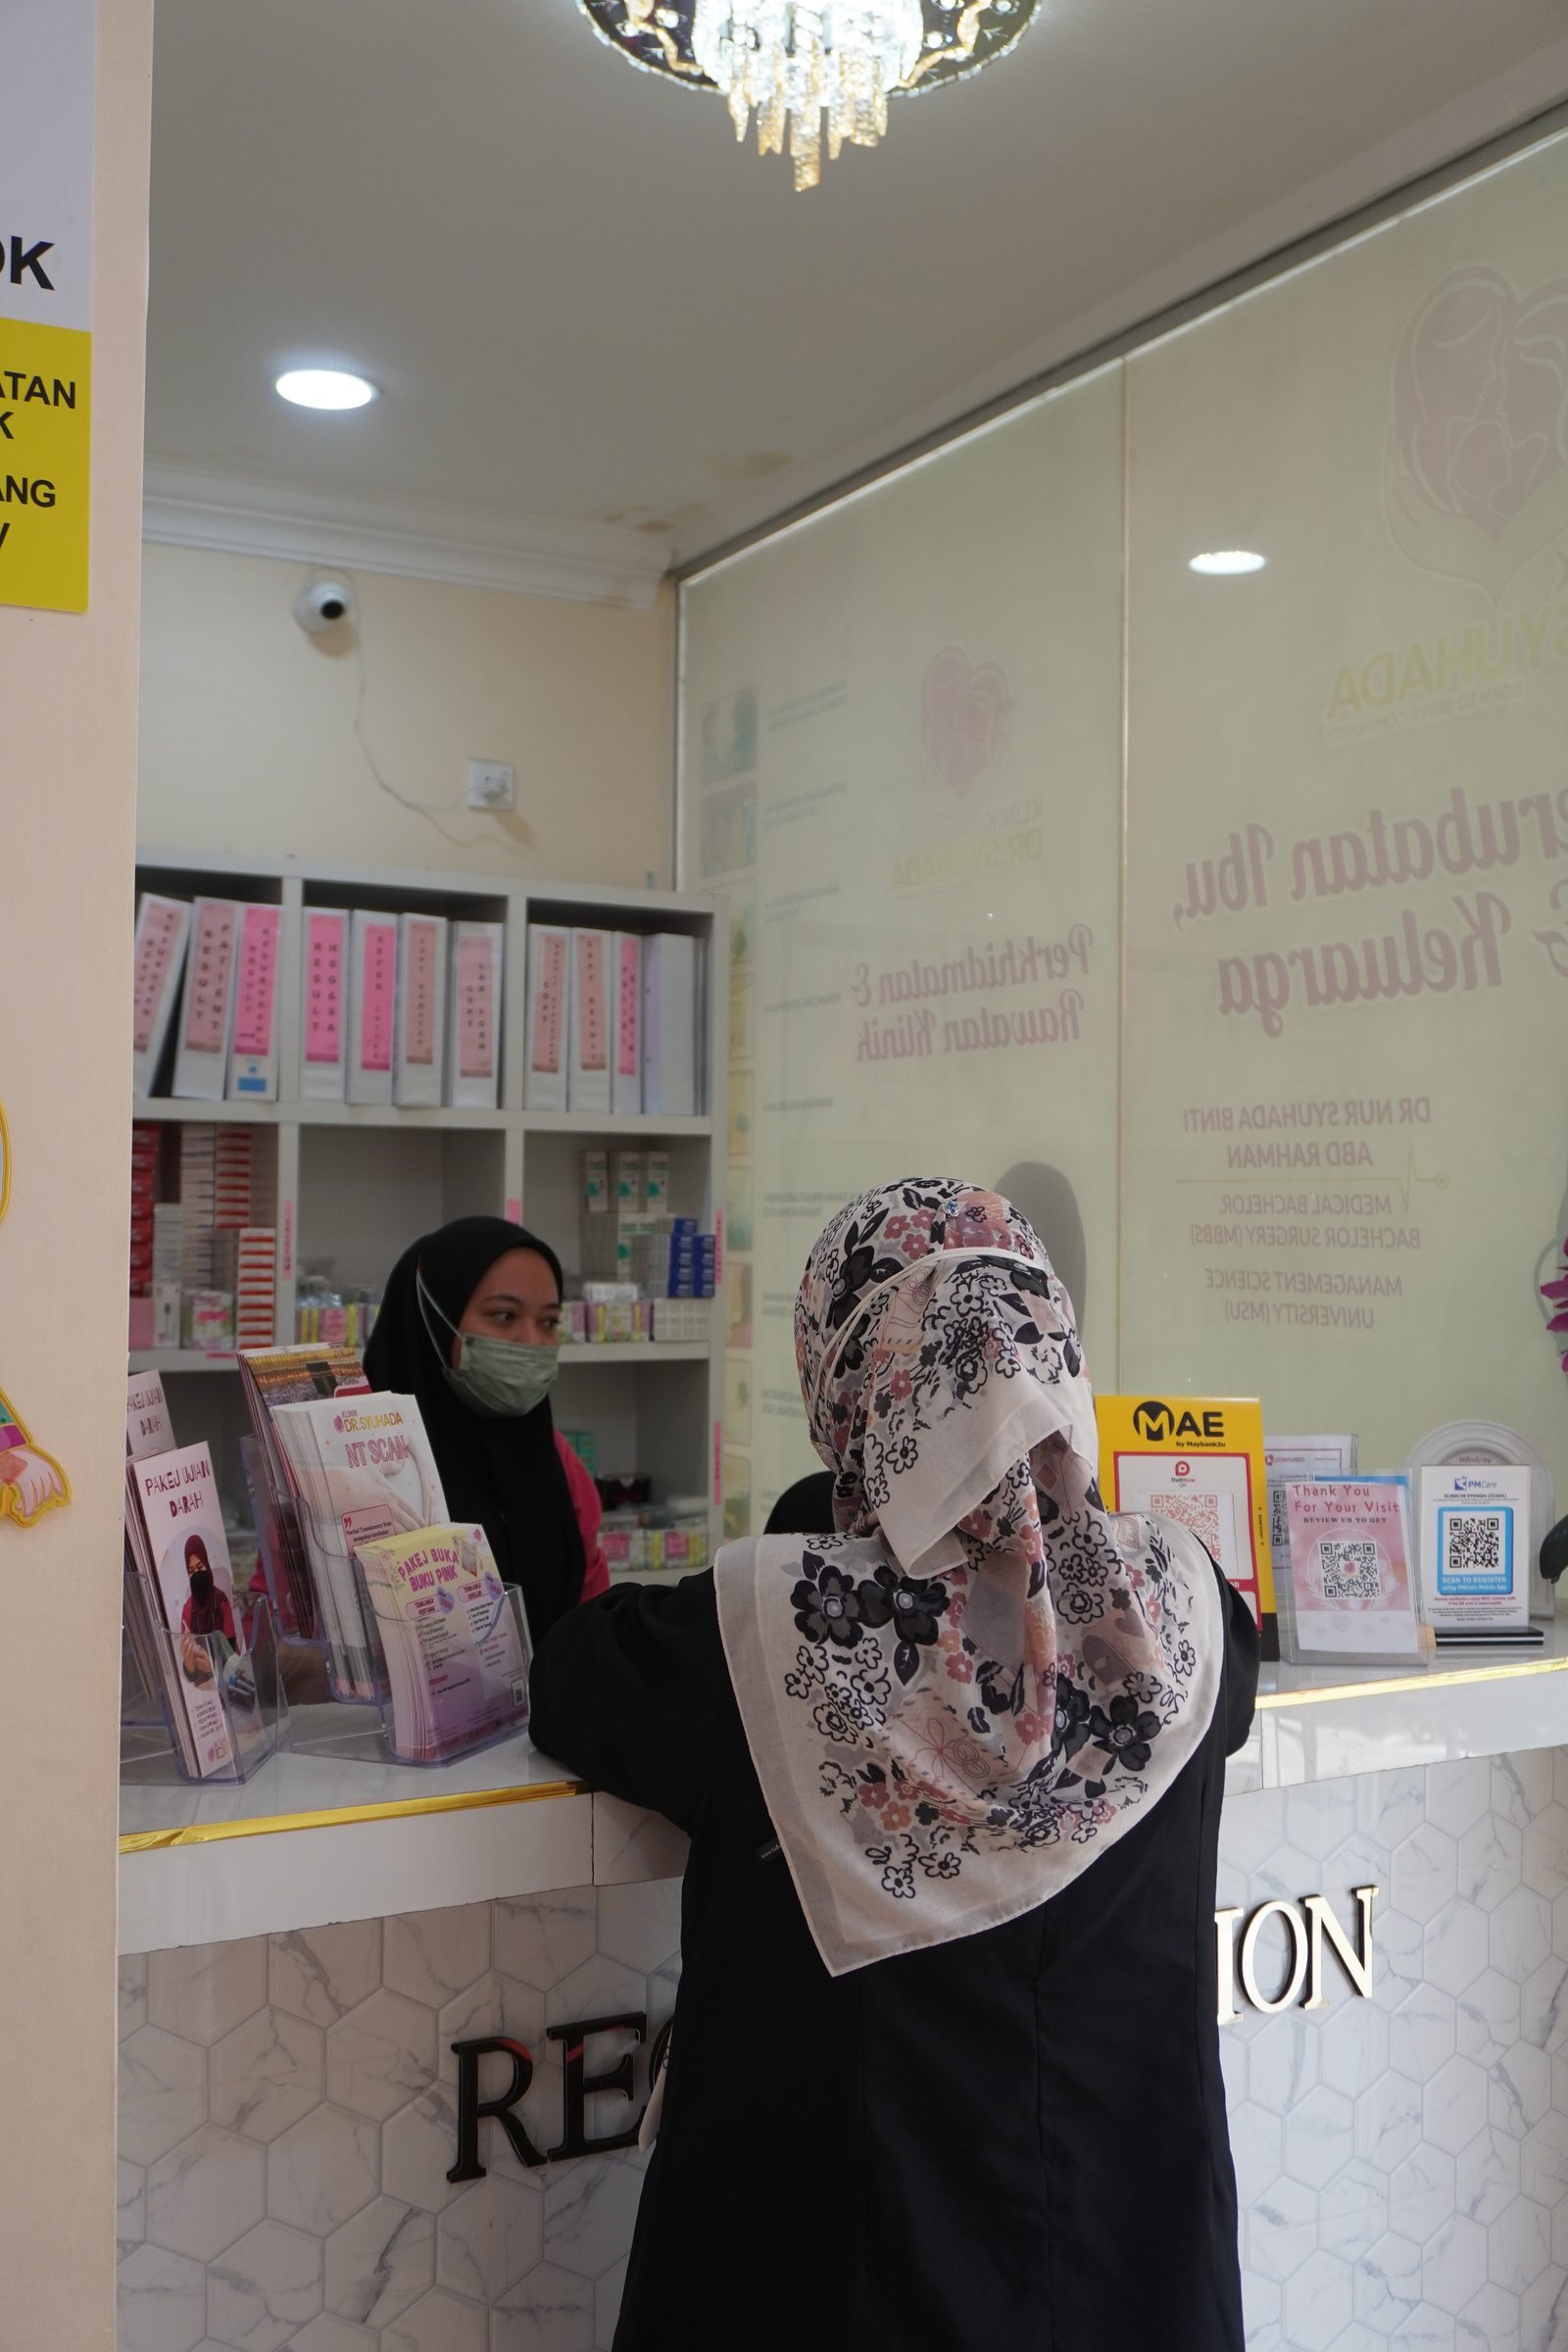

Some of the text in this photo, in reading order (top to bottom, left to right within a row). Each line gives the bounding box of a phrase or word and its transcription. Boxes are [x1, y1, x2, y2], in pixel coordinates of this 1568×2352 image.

[0, 236, 55, 291] K
[211, 923, 231, 1030] PATIENT
[343, 1411, 404, 1433] DR.SYUHADA
[1134, 1400, 1225, 1442] MAE
[345, 1435, 409, 1469] NT SCAN
[145, 1468, 181, 1496] PAKEJ
[1293, 1485, 1370, 1496] Thank You
[169, 1490, 205, 1519] DARAH
[1295, 1501, 1399, 1512] For Your Visit
[397, 1547, 460, 1581] PAKEJ BUKA
[410, 1565, 459, 1592] BUKU PINK
